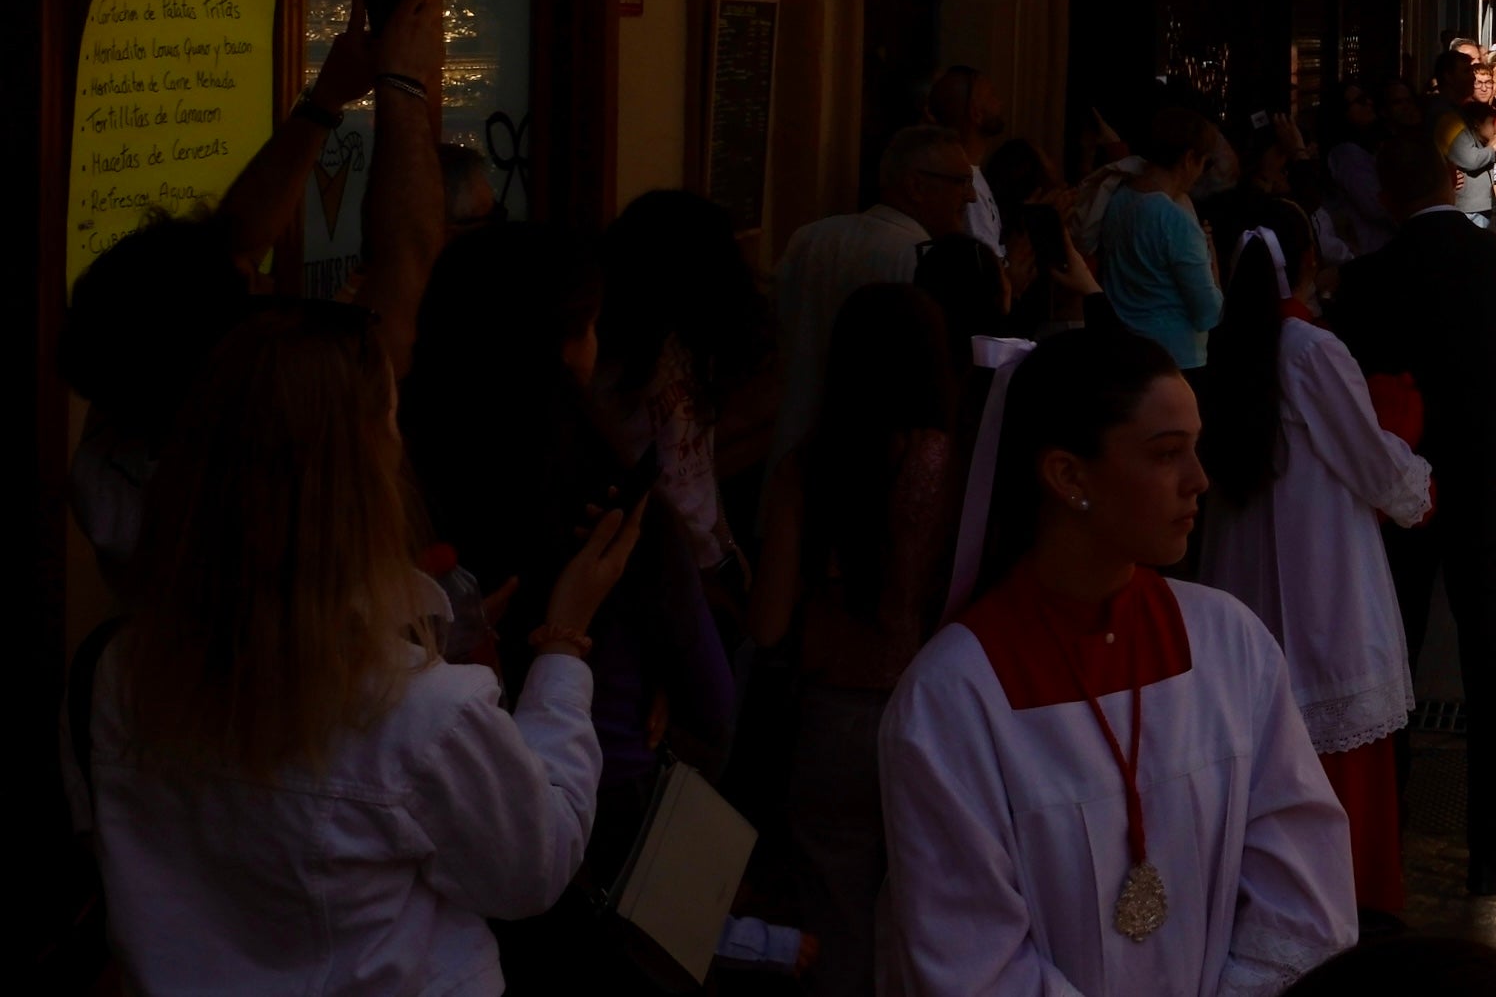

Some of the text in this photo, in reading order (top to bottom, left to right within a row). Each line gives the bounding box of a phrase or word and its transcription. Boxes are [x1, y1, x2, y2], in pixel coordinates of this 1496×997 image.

[144, 6, 157, 21] de
[94, 36, 146, 65] Montaditos
[214, 44, 223, 67] y
[90, 70, 145, 97] Montaditos
[148, 75, 159, 93] de
[163, 70, 192, 91] Carne
[86, 106, 150, 134] Tortillitas
[155, 105, 169, 126] de
[92, 138, 229, 176] Macetas de Cervezas
